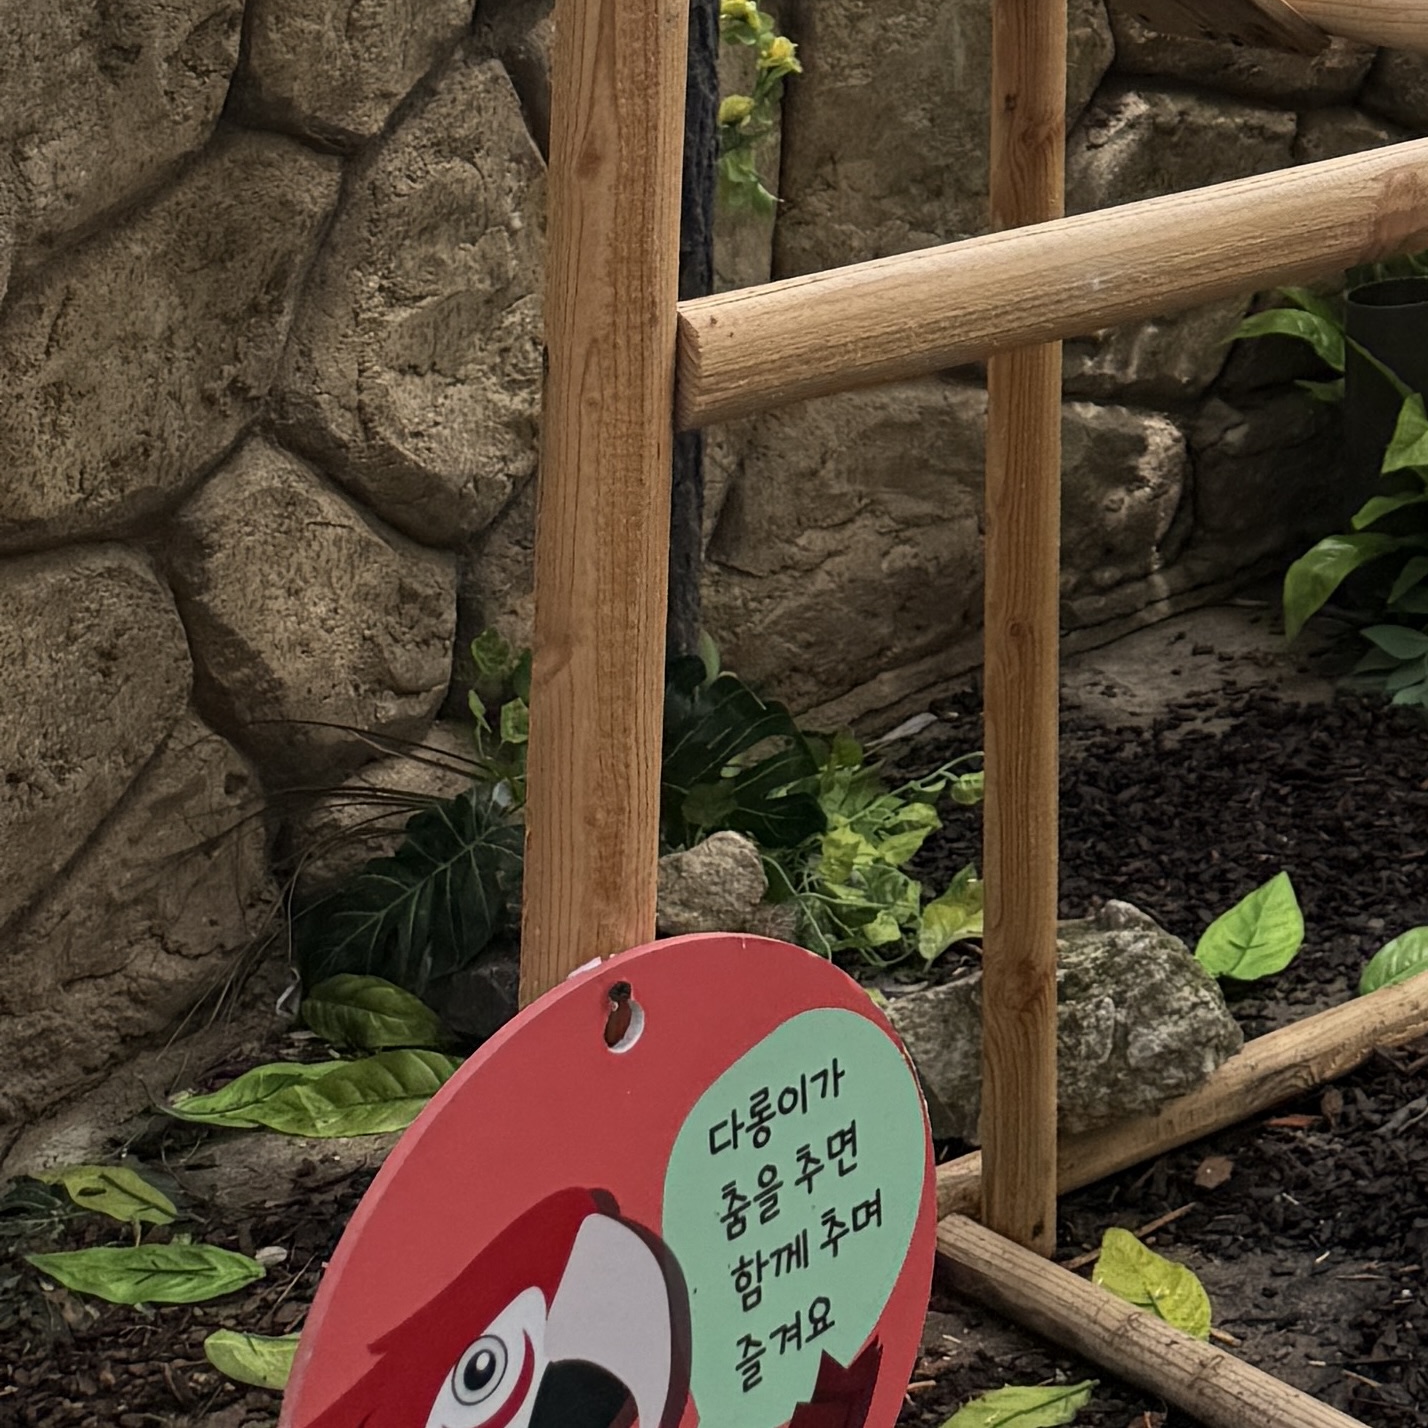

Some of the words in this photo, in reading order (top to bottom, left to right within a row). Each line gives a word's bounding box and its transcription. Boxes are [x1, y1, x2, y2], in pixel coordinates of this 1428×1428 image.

[709, 1057, 846, 1156] 다롱이가
[720, 1164, 784, 1241] 춤을
[794, 1119, 858, 1195] 추면
[730, 1228, 810, 1313] 함께
[819, 1187, 883, 1259] 추며
[735, 1296, 836, 1393] 즐겨요
